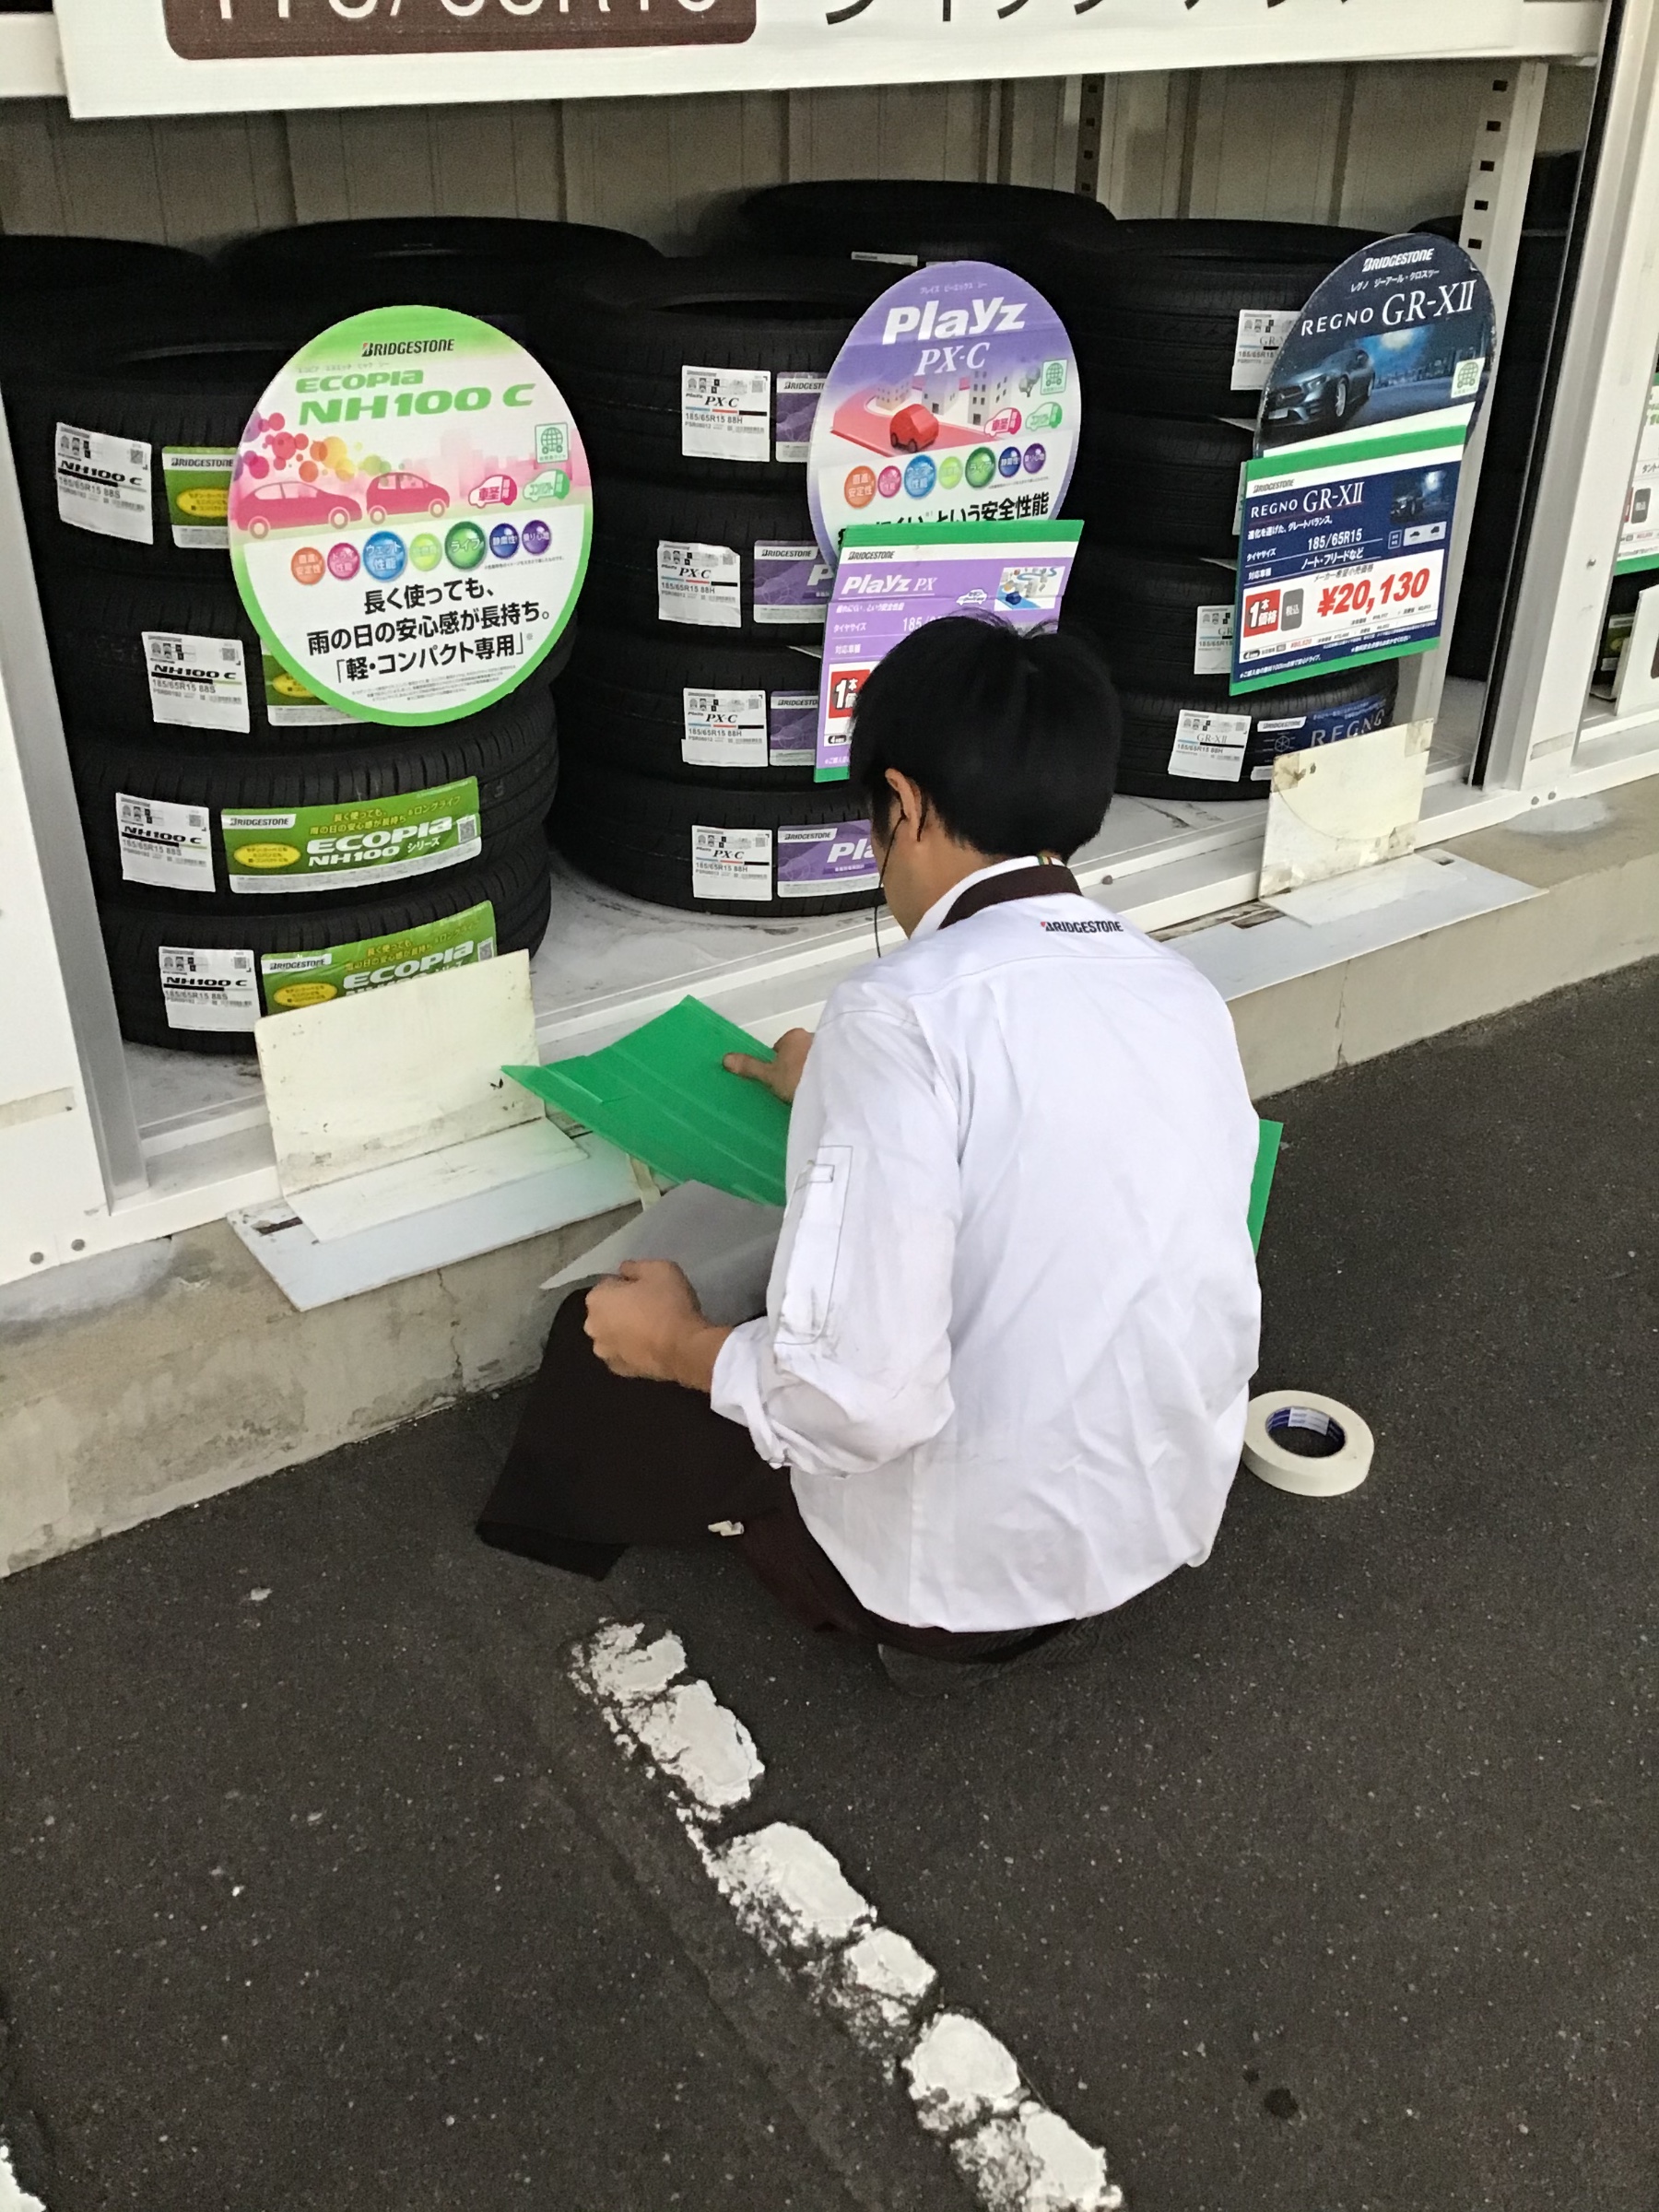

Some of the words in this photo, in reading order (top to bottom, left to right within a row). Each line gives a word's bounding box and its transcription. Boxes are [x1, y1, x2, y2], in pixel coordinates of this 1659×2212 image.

[1362, 247, 1435, 273] BRIDGESTONE
[1301, 307, 1374, 336] REGNO
[361, 338, 455, 358] BRIDGESTONE
[914, 342, 991, 376] PX-C
[299, 386, 492, 426] NH100
[502, 382, 537, 406] C
[685, 412, 725, 424] 185/65R15
[727, 415, 743, 424] 88H
[171, 457, 234, 467] BRIDGESTONE
[61, 460, 125, 483] NH100
[129, 477, 143, 487] C
[1253, 478, 1295, 494] BRIDGESTONE
[1251, 499, 1299, 519] REGNO
[450, 538, 481, 553] ライフ
[1307, 528, 1363, 551] 185/65R15
[761, 548, 812, 558] BRIDGESTONE
[847, 550, 895, 560] BRIDGESTONE
[1300, 547, 1365, 571] ノート・フリードなど
[913, 577, 938, 592] PX
[1317, 568, 1430, 618] ¥20,130
[363, 577, 495, 615] 長く使っても、
[306, 600, 550, 656] 雨の日の安心感が長持ち。
[335, 631, 524, 684] 「軽・コンパクト専用」
[154, 664, 220, 678] NH100
[223, 672, 237, 680] C
[688, 728, 726, 736] 185/65R15
[727, 728, 742, 737] 88H
[229, 818, 289, 827] BRIDGESTONE
[124, 826, 186, 842] NH100
[783, 831, 831, 841] BRIDGESTONE
[308, 845, 400, 866] NH100
[407, 836, 441, 853] シリーズ
[1041, 920, 1124, 934] BRIDGESTONE
[166, 976, 231, 987] NH100
[235, 979, 248, 987] C
